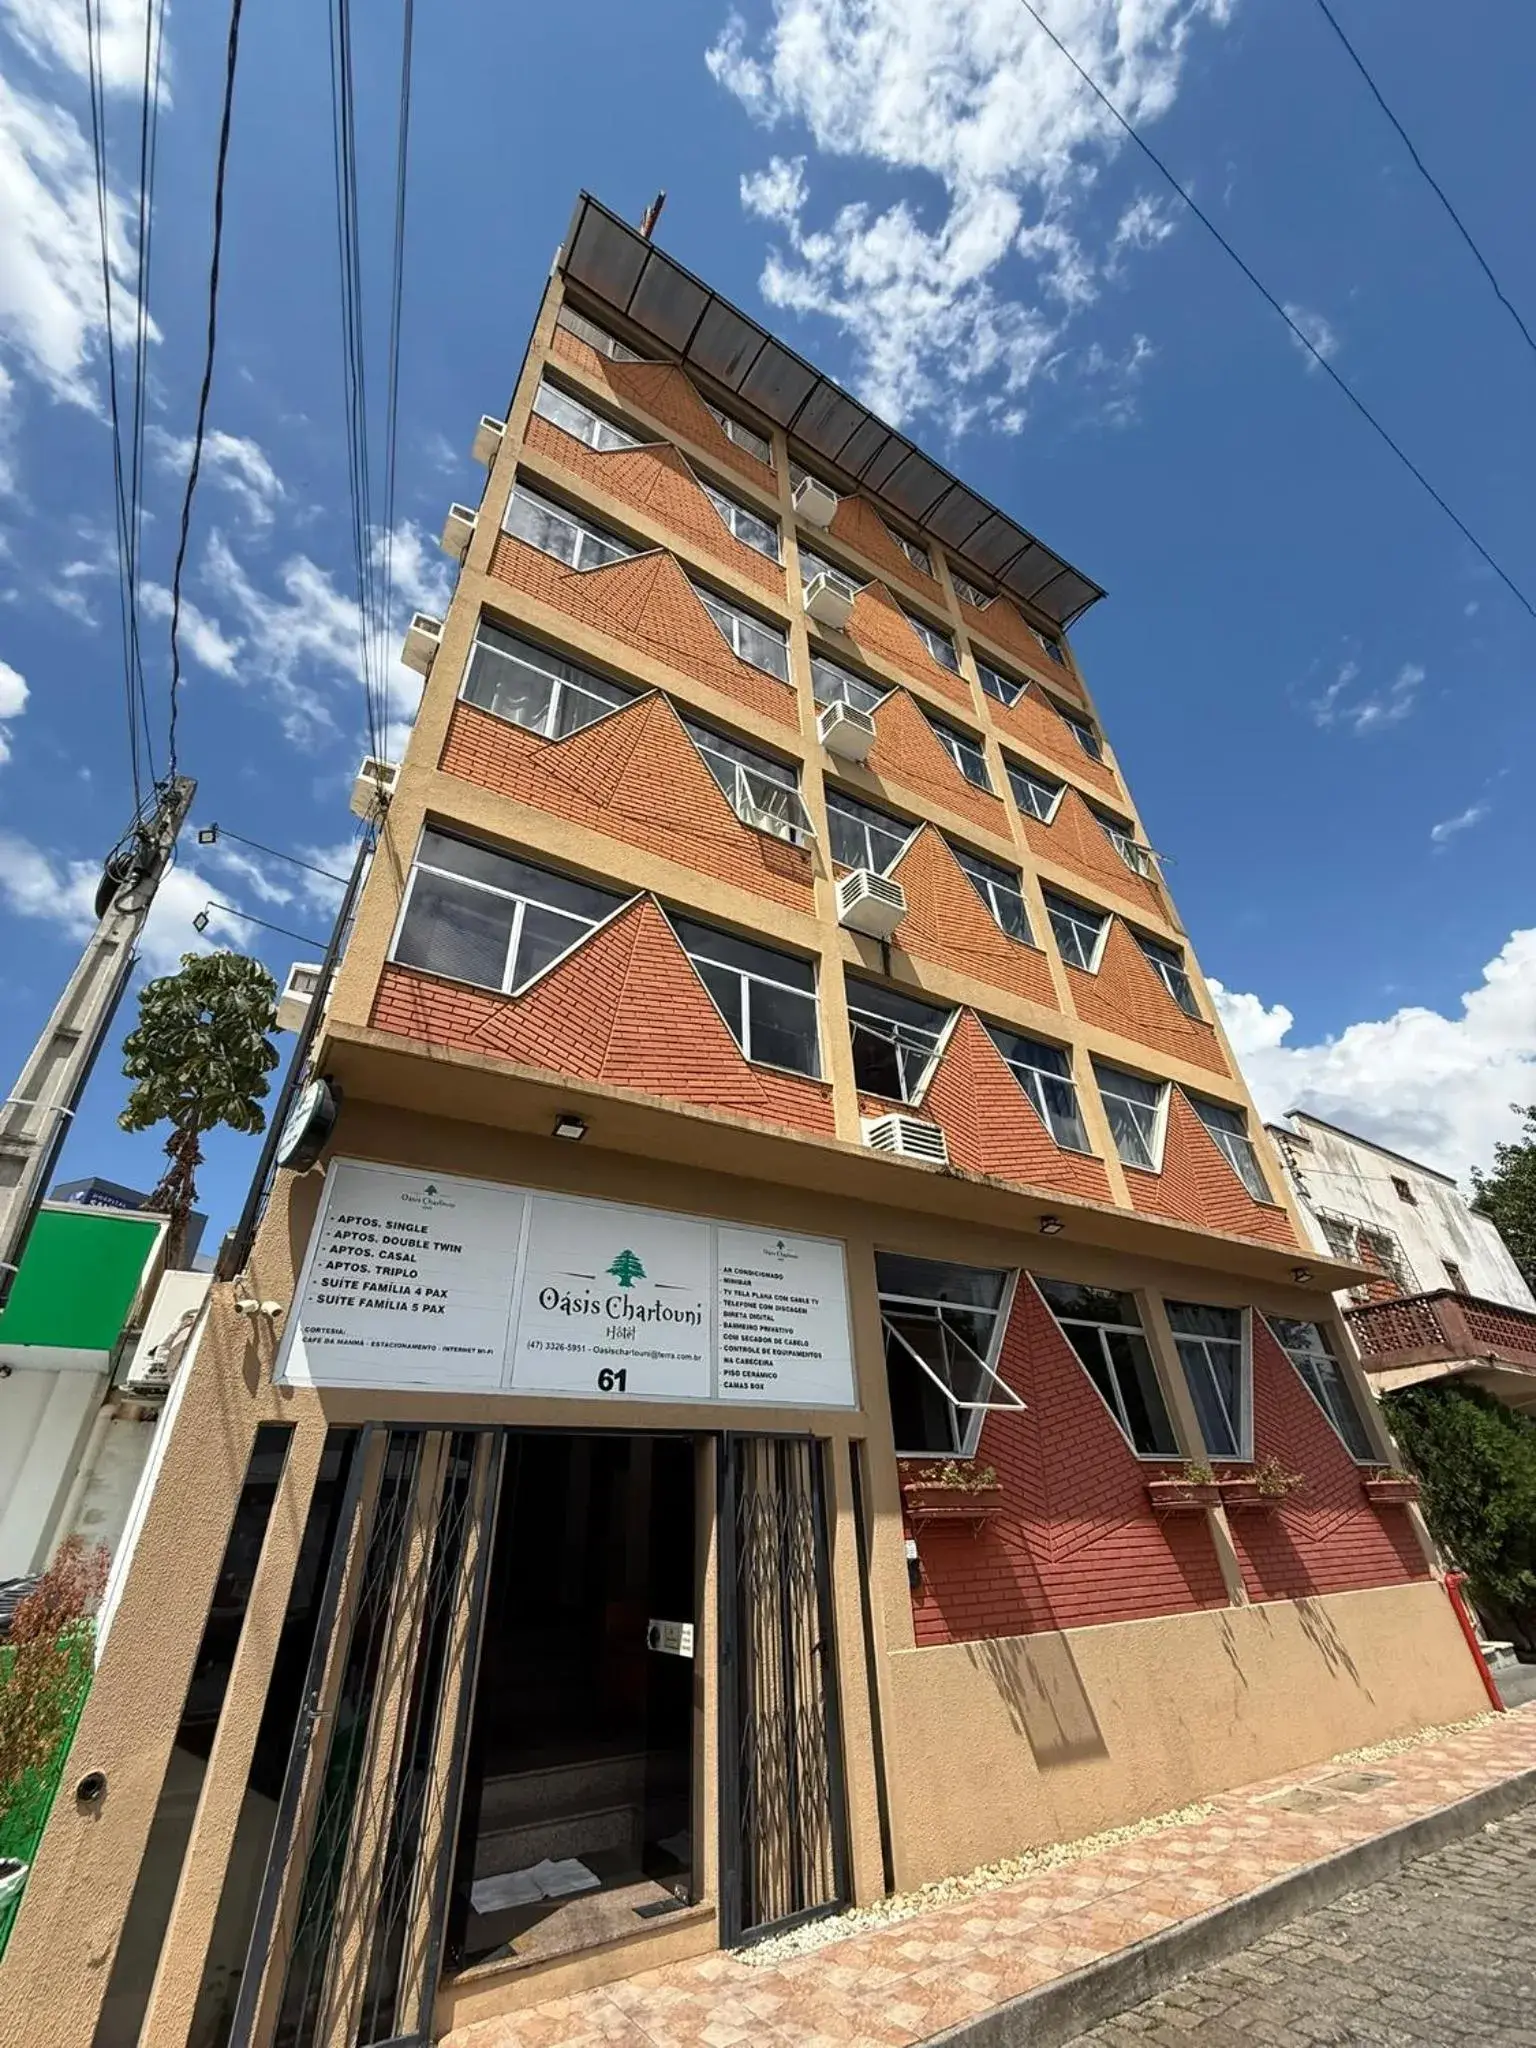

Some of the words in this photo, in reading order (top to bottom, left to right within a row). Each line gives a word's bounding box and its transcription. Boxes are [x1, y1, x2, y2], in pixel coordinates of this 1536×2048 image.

[338, 1215, 382, 1228] APTOS.
[386, 1221, 429, 1234] SINGLE
[334, 1230, 378, 1244] APTOS.
[382, 1236, 430, 1249] DOUBLE
[433, 1242, 462, 1254] TWIN
[330, 1245, 374, 1258] APTOS.
[378, 1250, 417, 1262] CASAL
[326, 1261, 371, 1274] APTOS.
[375, 1266, 418, 1278] TRIPLO
[734, 1268, 784, 1280] CONDICIONADO
[414, 1288, 422, 1296] 4
[425, 1288, 448, 1298] PAX
[723, 1288, 732, 1296] TV
[734, 1290, 750, 1298] TELA
[774, 1294, 788, 1302] COM
[811, 1298, 820, 1306] TV
[411, 1303, 419, 1312] 5
[422, 1304, 446, 1314] PAX
[606, 1294, 702, 1326] Chartouni
[723, 1300, 757, 1309] TELEFONE
[758, 1303, 774, 1311] COM
[723, 1310, 748, 1319] DIRETA
[749, 1312, 775, 1322] DIGITAL
[526, 1340, 544, 1350] (47)
[740, 1334, 772, 1344] SECADOR
[784, 1338, 809, 1347] CABELO
[370, 1341, 437, 1352] ESTACIONAMENTO
[442, 1346, 476, 1354] INTERNET
[723, 1344, 760, 1354] CONTROLE
[772, 1348, 822, 1359] EQUIPAMENTOS
[598, 1368, 628, 1392] 61
[723, 1381, 749, 1390] CAMAS
[750, 1382, 765, 1390] BOX
